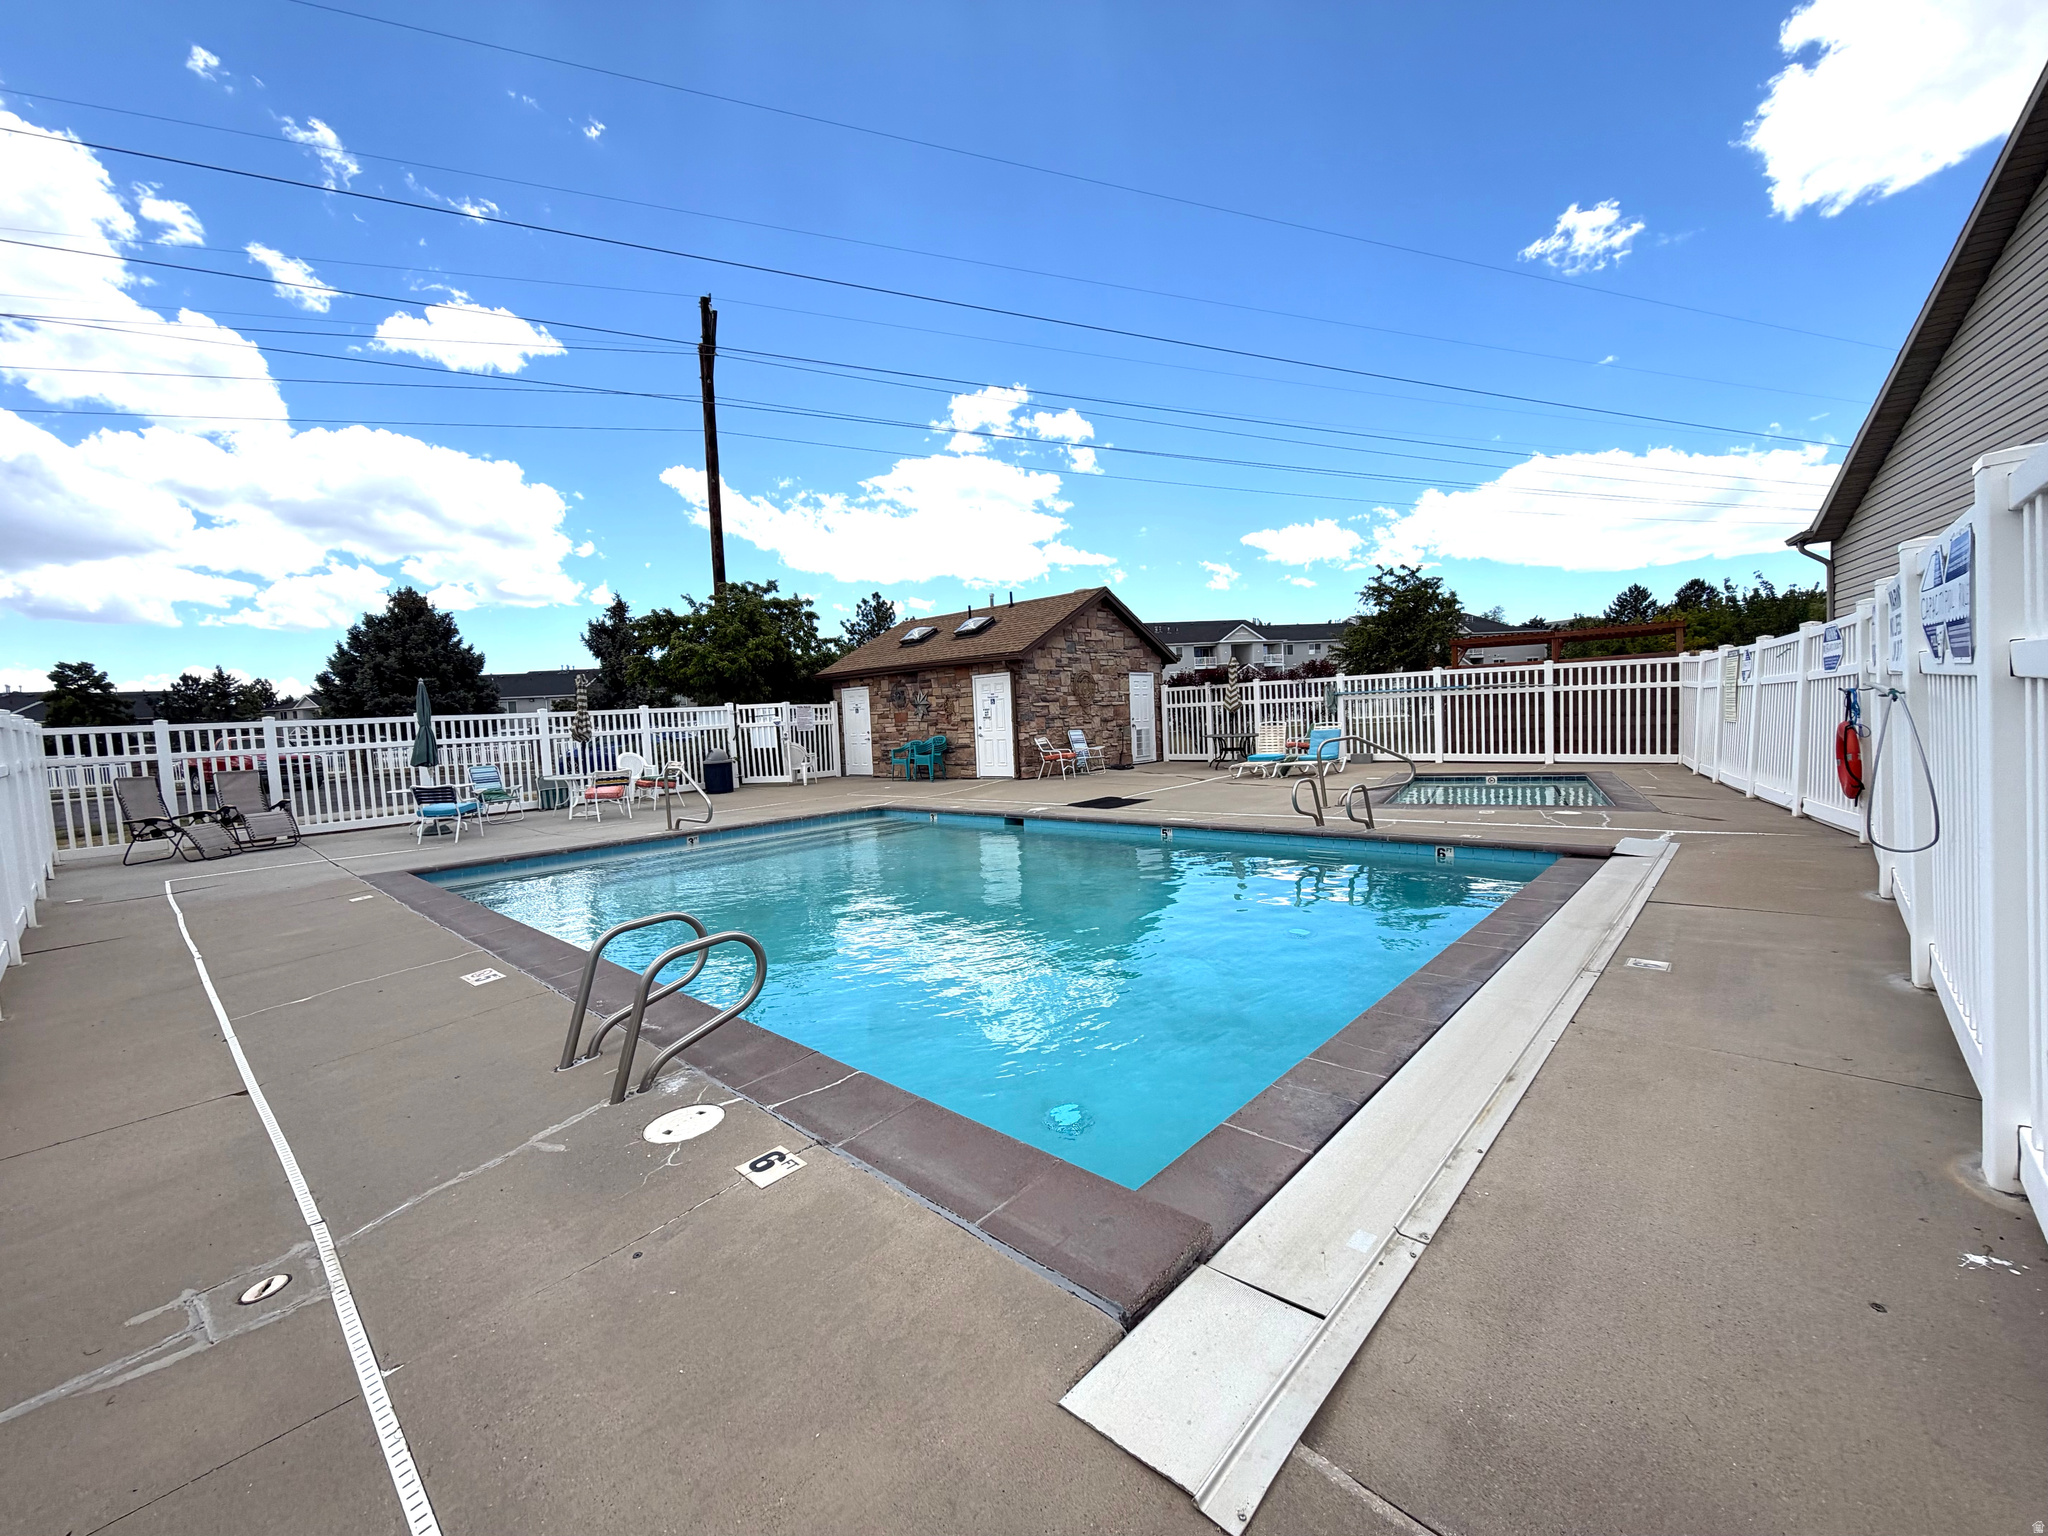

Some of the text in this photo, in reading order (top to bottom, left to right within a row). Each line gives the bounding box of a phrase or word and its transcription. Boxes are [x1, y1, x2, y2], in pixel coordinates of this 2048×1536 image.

[1437, 847, 1447, 859] 6
[749, 1151, 800, 1173] 6 FT
